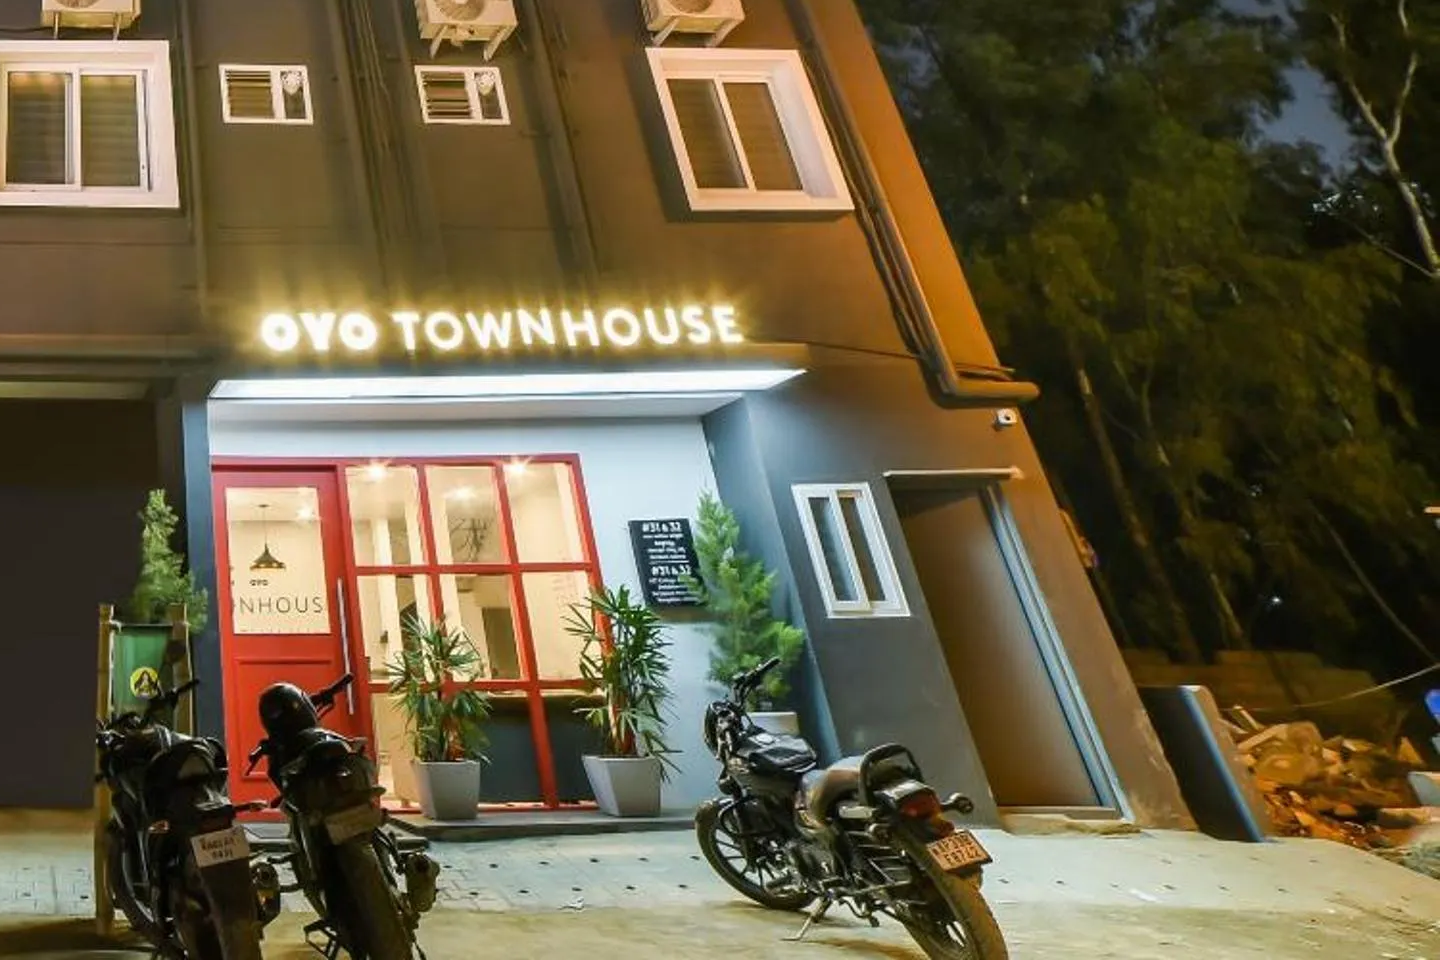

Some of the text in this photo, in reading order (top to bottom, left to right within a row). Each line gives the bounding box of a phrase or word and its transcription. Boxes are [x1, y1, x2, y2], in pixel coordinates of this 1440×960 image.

[260, 305, 745, 352] OYO TOWNHOUSE
[233, 596, 324, 614] NHOUS
